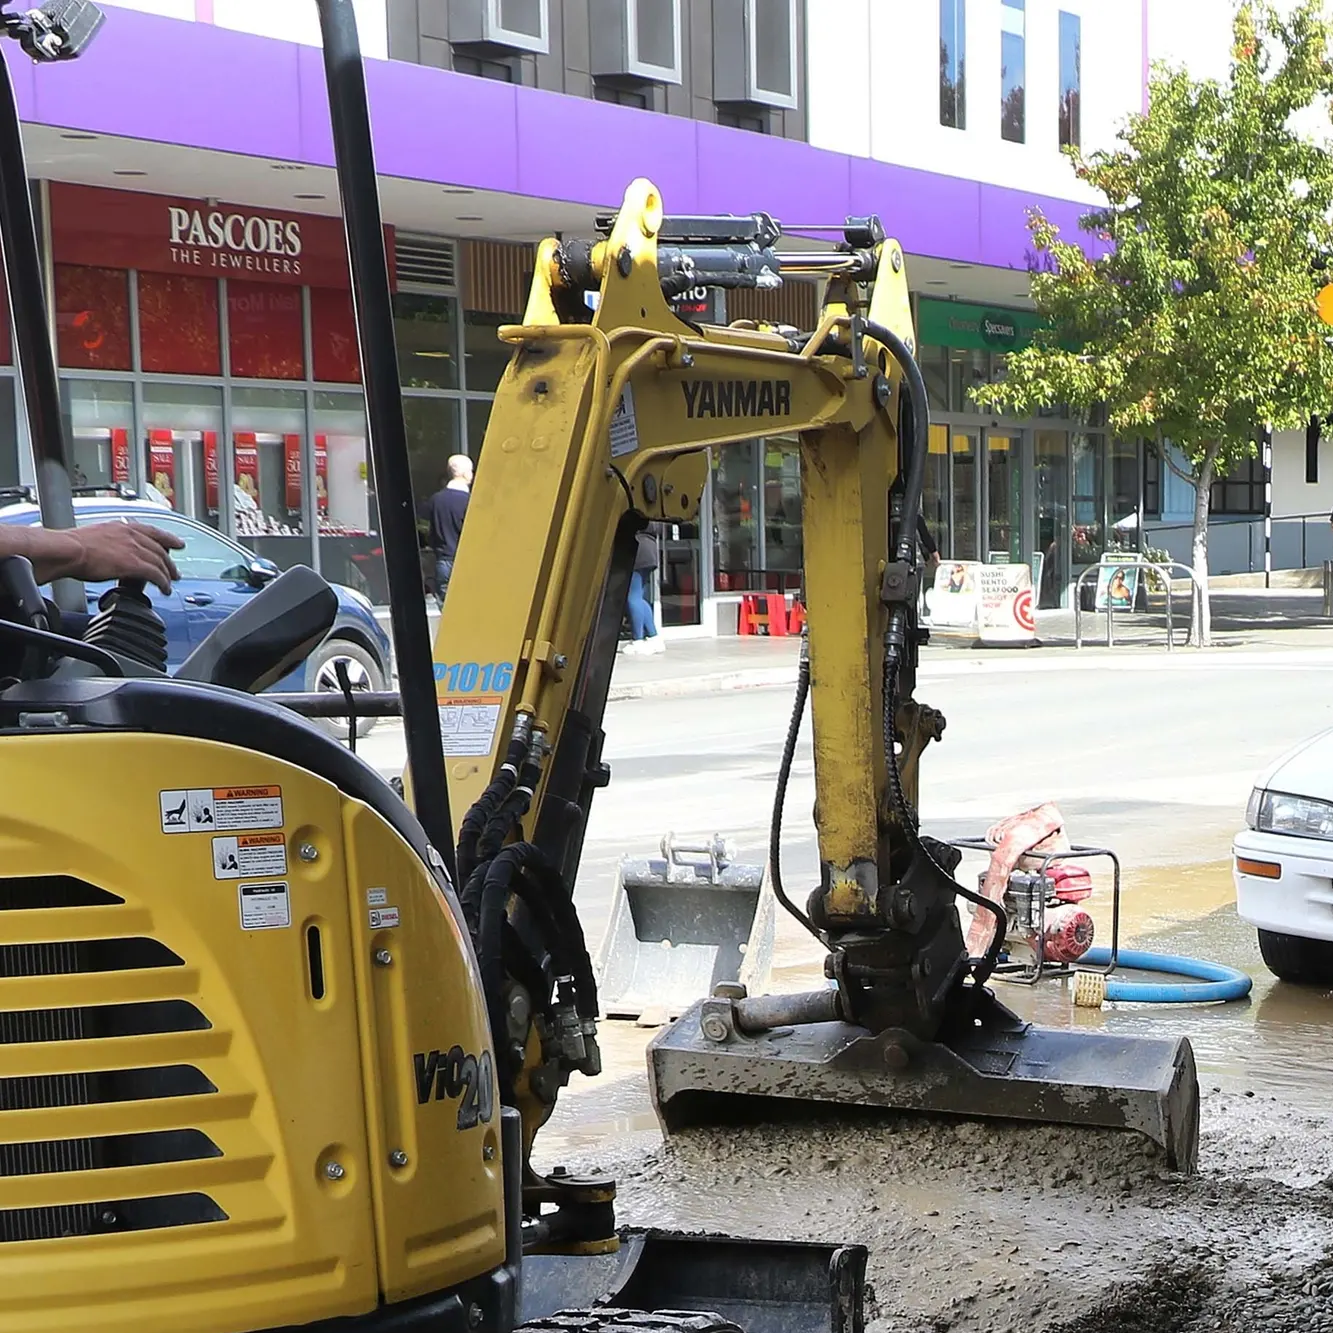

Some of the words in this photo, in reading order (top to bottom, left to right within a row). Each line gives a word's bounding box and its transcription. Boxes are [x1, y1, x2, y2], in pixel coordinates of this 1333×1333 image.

[168, 206, 302, 257] PASCOES
[170, 248, 201, 266] THE
[211, 252, 301, 275] JEWELLERS
[681, 380, 791, 419] YANMAR
[234, 788, 268, 796] WARNING
[248, 835, 280, 844] WARNING
